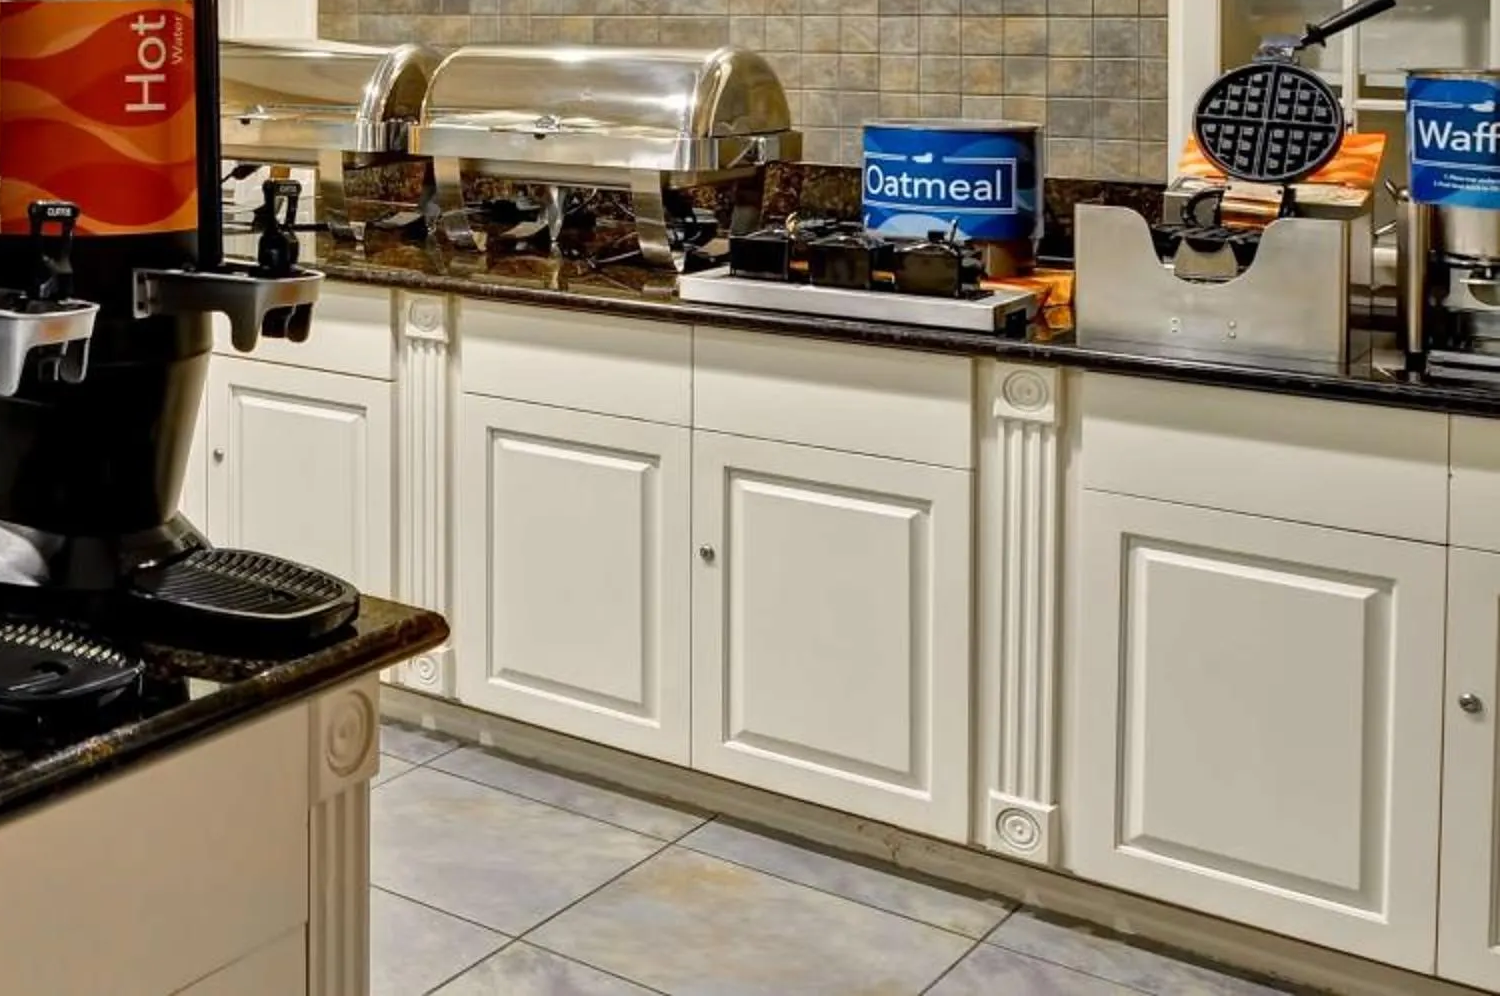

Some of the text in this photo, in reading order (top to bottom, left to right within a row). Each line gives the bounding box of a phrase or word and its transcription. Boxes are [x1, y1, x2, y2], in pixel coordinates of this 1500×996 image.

[171, 15, 184, 65] Water
[125, 14, 166, 112] Hot
[1417, 118, 1500, 154] Waff
[866, 164, 1002, 201] Oatmeal
